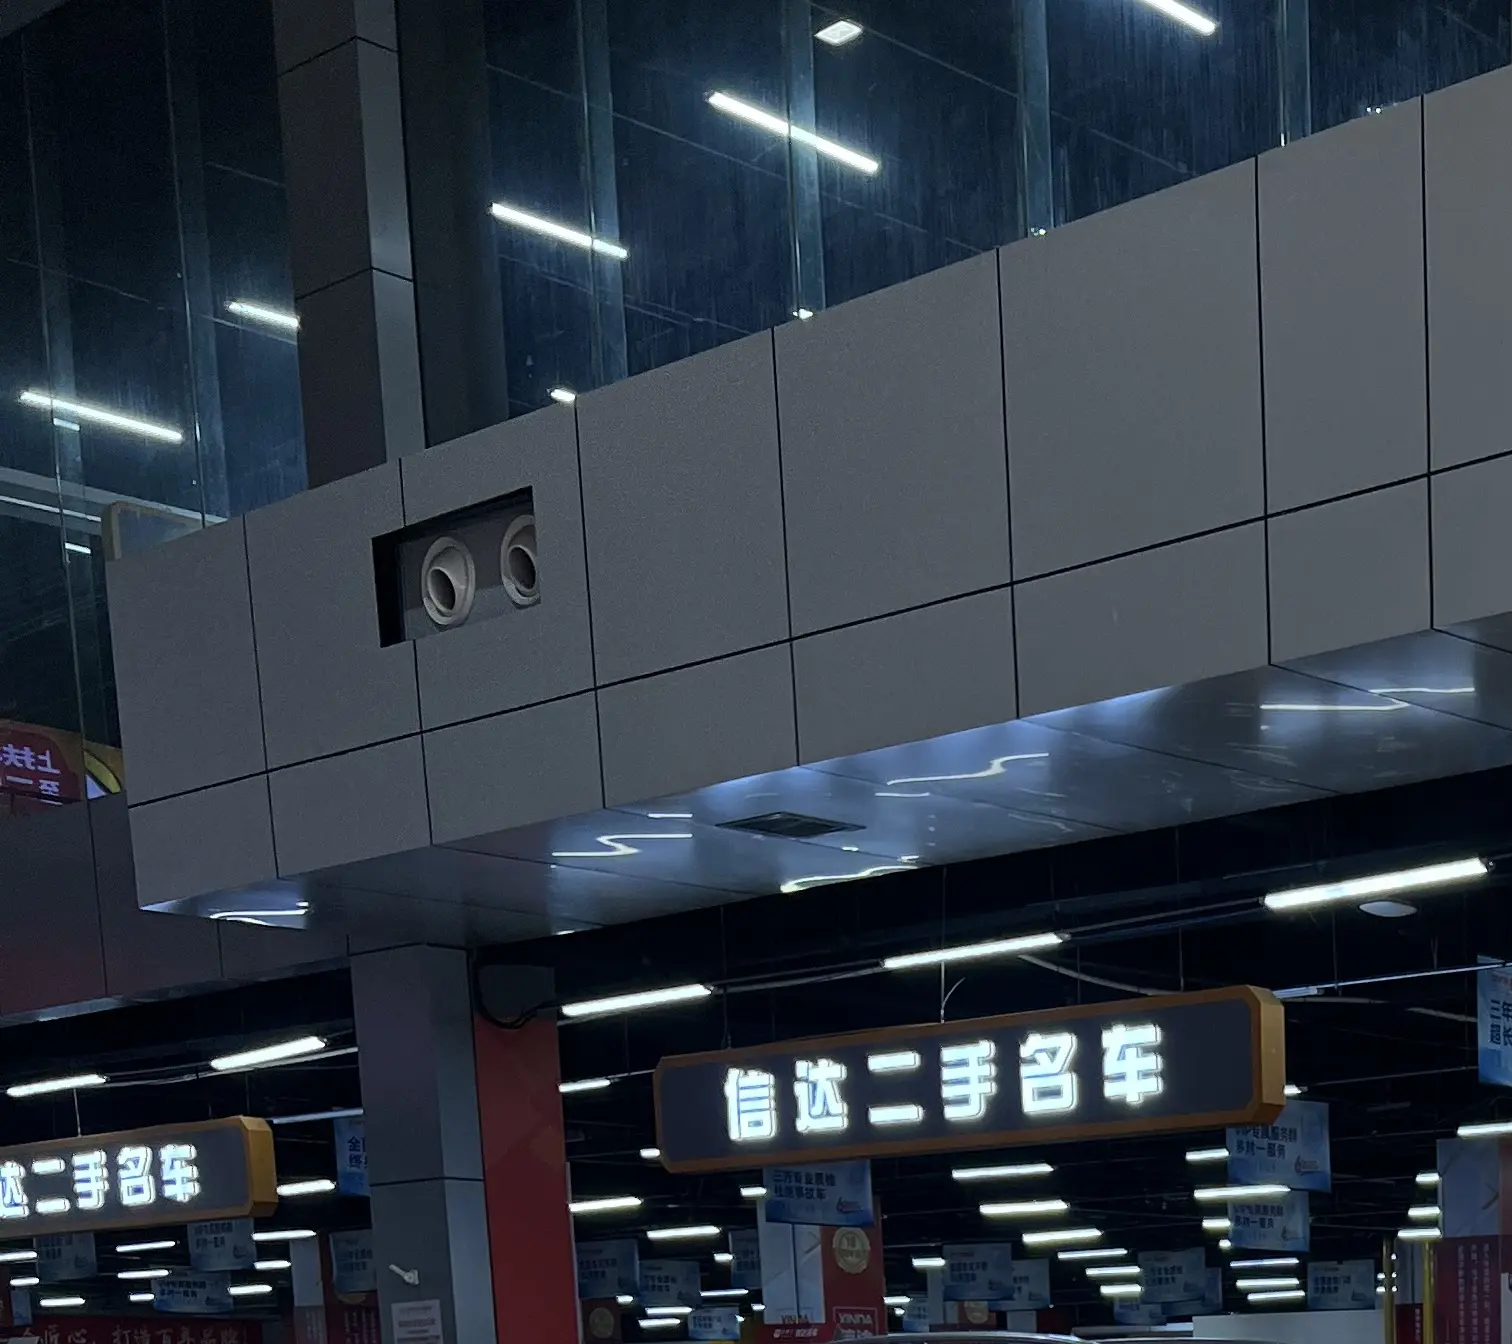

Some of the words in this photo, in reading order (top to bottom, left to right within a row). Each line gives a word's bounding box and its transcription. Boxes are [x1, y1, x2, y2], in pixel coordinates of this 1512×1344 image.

[724, 1022, 1164, 1142] 信达二手名车
